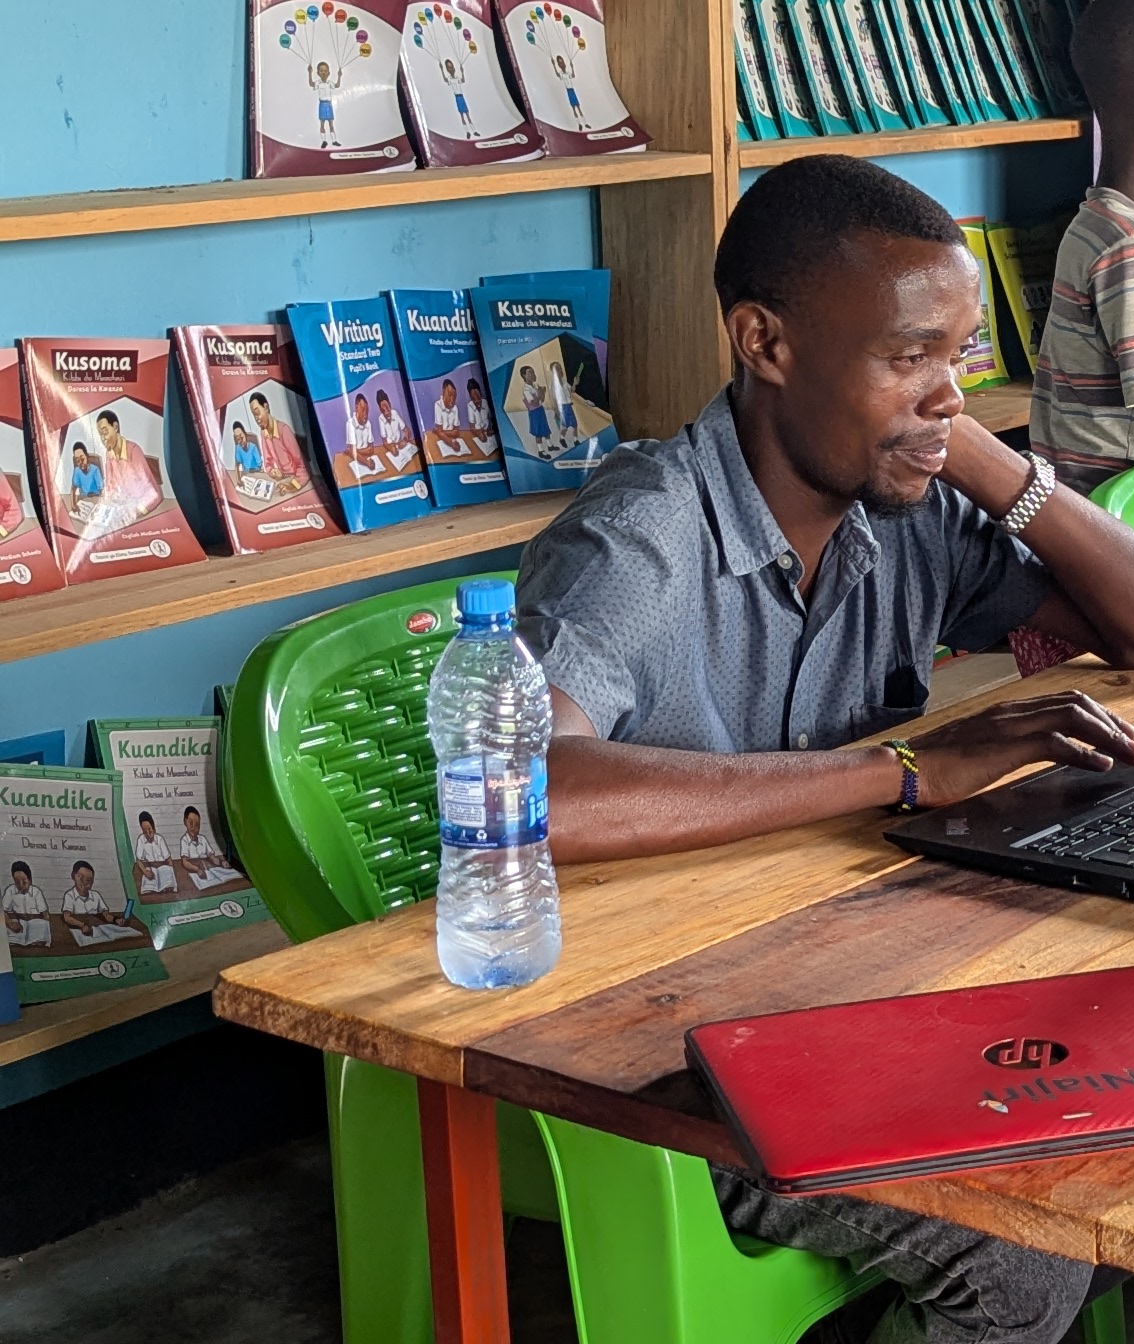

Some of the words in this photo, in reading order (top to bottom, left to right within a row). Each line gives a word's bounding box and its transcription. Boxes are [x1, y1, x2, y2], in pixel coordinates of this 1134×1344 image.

[406, 308, 476, 331] Kuandik
[497, 301, 571, 317] Kusoma
[320, 319, 383, 347] Writing
[206, 338, 273, 355] Kusoma
[55, 351, 132, 371] Kusoma
[118, 737, 213, 759] Kuandika
